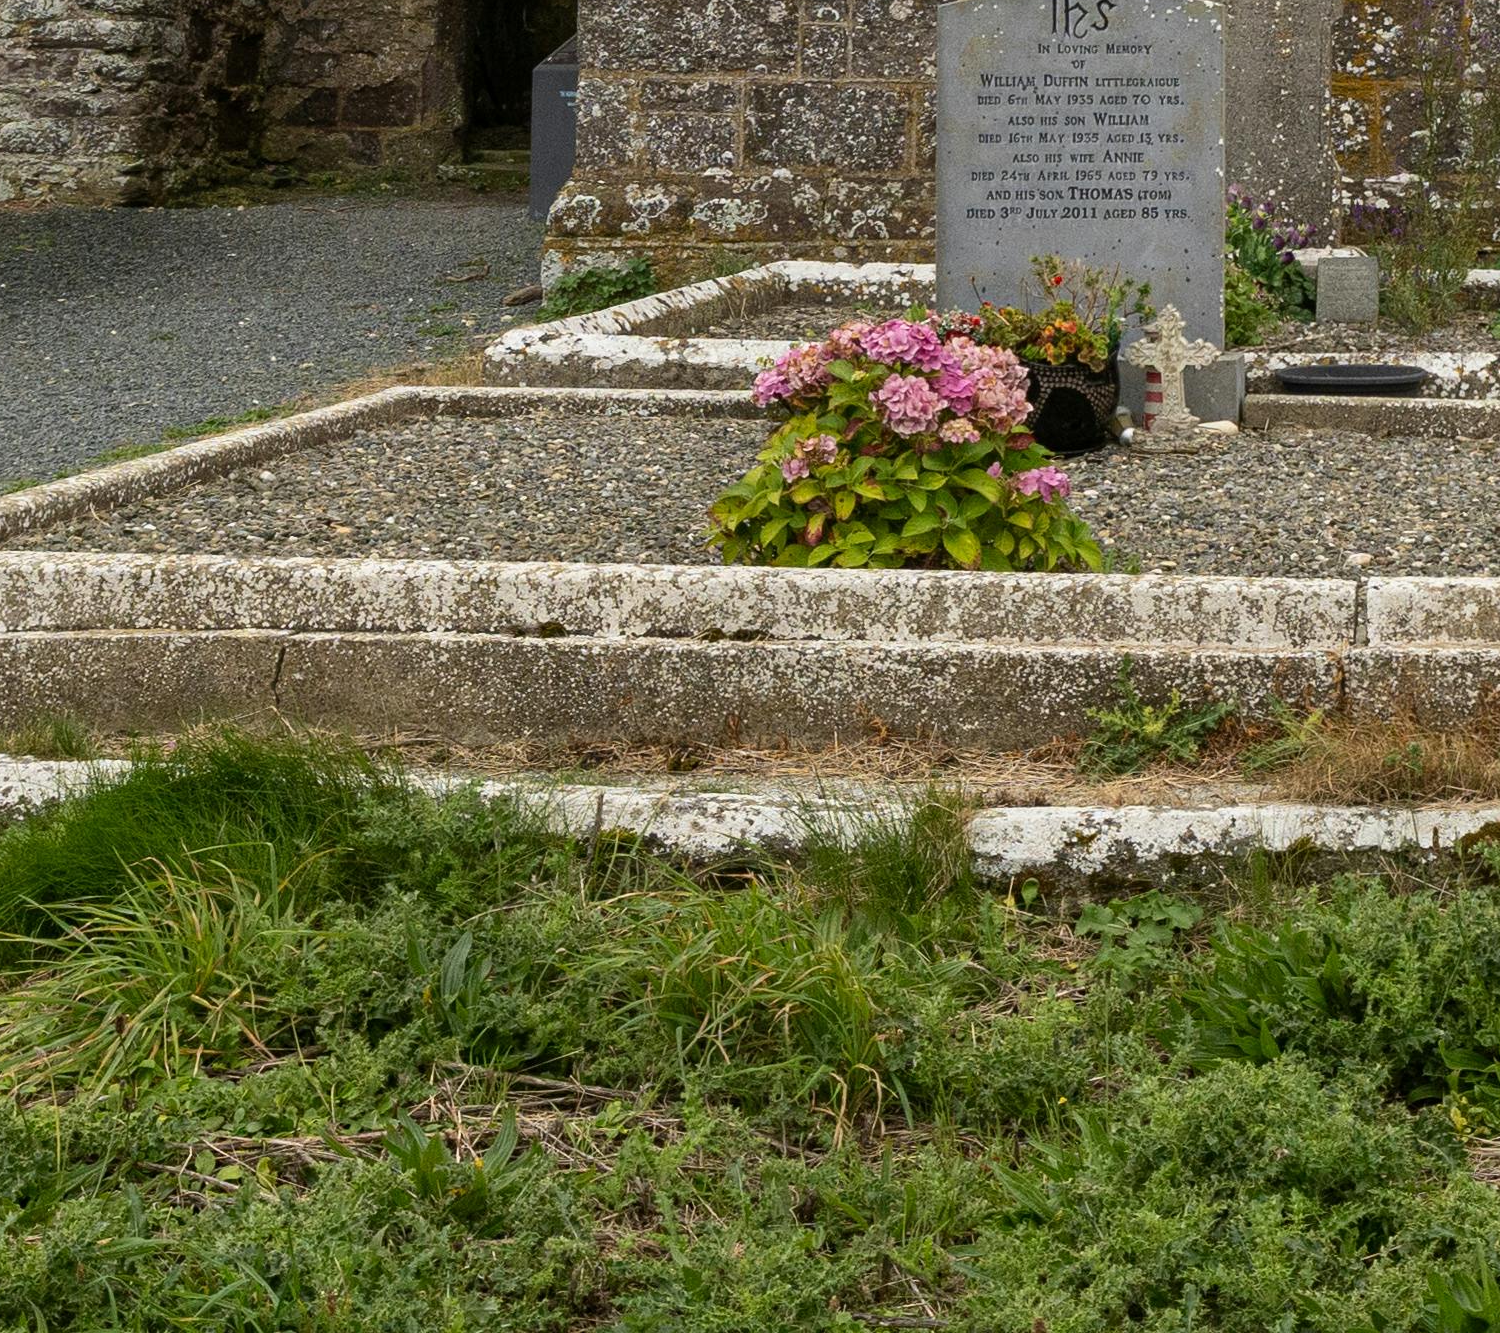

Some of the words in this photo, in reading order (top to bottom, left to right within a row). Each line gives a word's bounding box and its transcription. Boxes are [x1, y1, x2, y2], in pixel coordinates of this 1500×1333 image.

[1038, 44, 1051, 54] IN
[1058, 44, 1099, 54] LOVING
[1106, 44, 1153, 55] MEMORY
[1072, 60, 1086, 69] OF
[980, 74, 1035, 88] WILLIAM
[1043, 75, 1089, 87] DUFFIN
[977, 95, 1001, 105] DIED
[1008, 95, 1028, 105] 6TH
[1035, 95, 1061, 105] MAY
[1067, 95, 1094, 105] 1935
[1100, 95, 1127, 105] AGED
[1132, 95, 1151, 105] 70
[1159, 95, 1184, 106] YRS.
[1008, 116, 1034, 126] ALSO
[1041, 116, 1057, 126] HIS
[1064, 116, 1085, 126] SON
[1093, 113, 1149, 126] WILLIAM
[978, 133, 1002, 144] DIED
[1009, 133, 1033, 144] 16TH
[1039, 133, 1064, 144] MAY
[1072, 133, 1099, 143] 1935
[1107, 133, 1134, 144] AGED
[1158, 134, 1184, 144] YRS.
[1013, 154, 1039, 163] ALSO
[1044, 154, 1062, 163] HIS
[1070, 154, 1095, 163] WIFE
[1103, 151, 1144, 163] ANNIE
[971, 171, 995, 181] DIED
[1001, 171, 1030, 181] 24TH
[1037, 171, 1069, 181] APRIL
[1075, 171, 1102, 181] 1965
[1108, 171, 1135, 181] AGED
[1142, 171, 1158, 181] 79
[1164, 171, 1190, 181] YRS.
[987, 190, 1011, 200] AND
[1015, 190, 1035, 200] HIS
[1039, 190, 1064, 200] SON
[1068, 187, 1133, 200] THOMAS
[1138, 190, 1172, 201] (TOM)
[966, 209, 995, 219] DIED
[1000, 208, 1022, 219] 3RD
[1026, 208, 1058, 219] JULY
[1060, 208, 1097, 219] 2011
[1103, 209, 1136, 219] AGED
[1142, 208, 1159, 218] 85
[1164, 209, 1190, 219] YRS.
